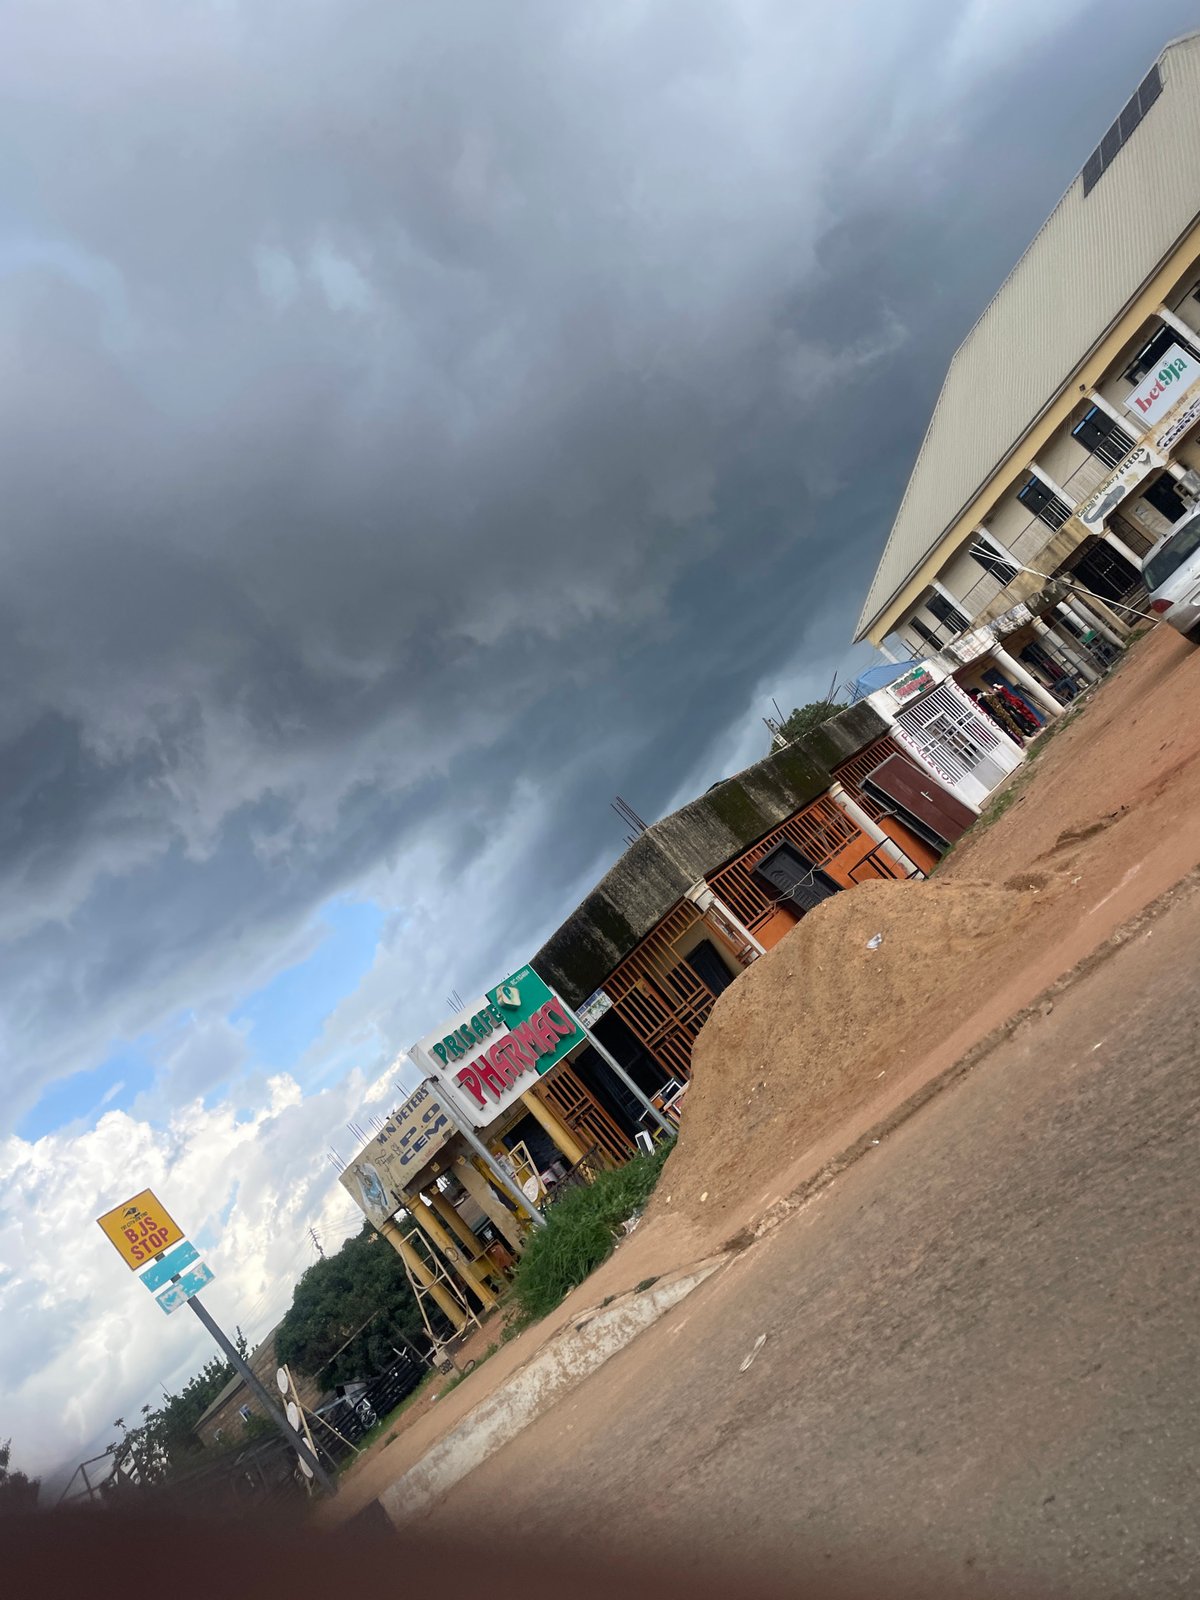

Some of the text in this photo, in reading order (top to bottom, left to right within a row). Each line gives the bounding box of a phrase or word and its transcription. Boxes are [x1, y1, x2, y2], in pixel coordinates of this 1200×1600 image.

[1135, 358, 1187, 413] bet9ja
[1118, 447, 1145, 475] FEEDS
[431, 1003, 505, 1066] PRISAFE
[455, 995, 576, 1107] PHARMACY
[400, 1113, 449, 1166] CEM
[130, 1226, 169, 1261] STOP
